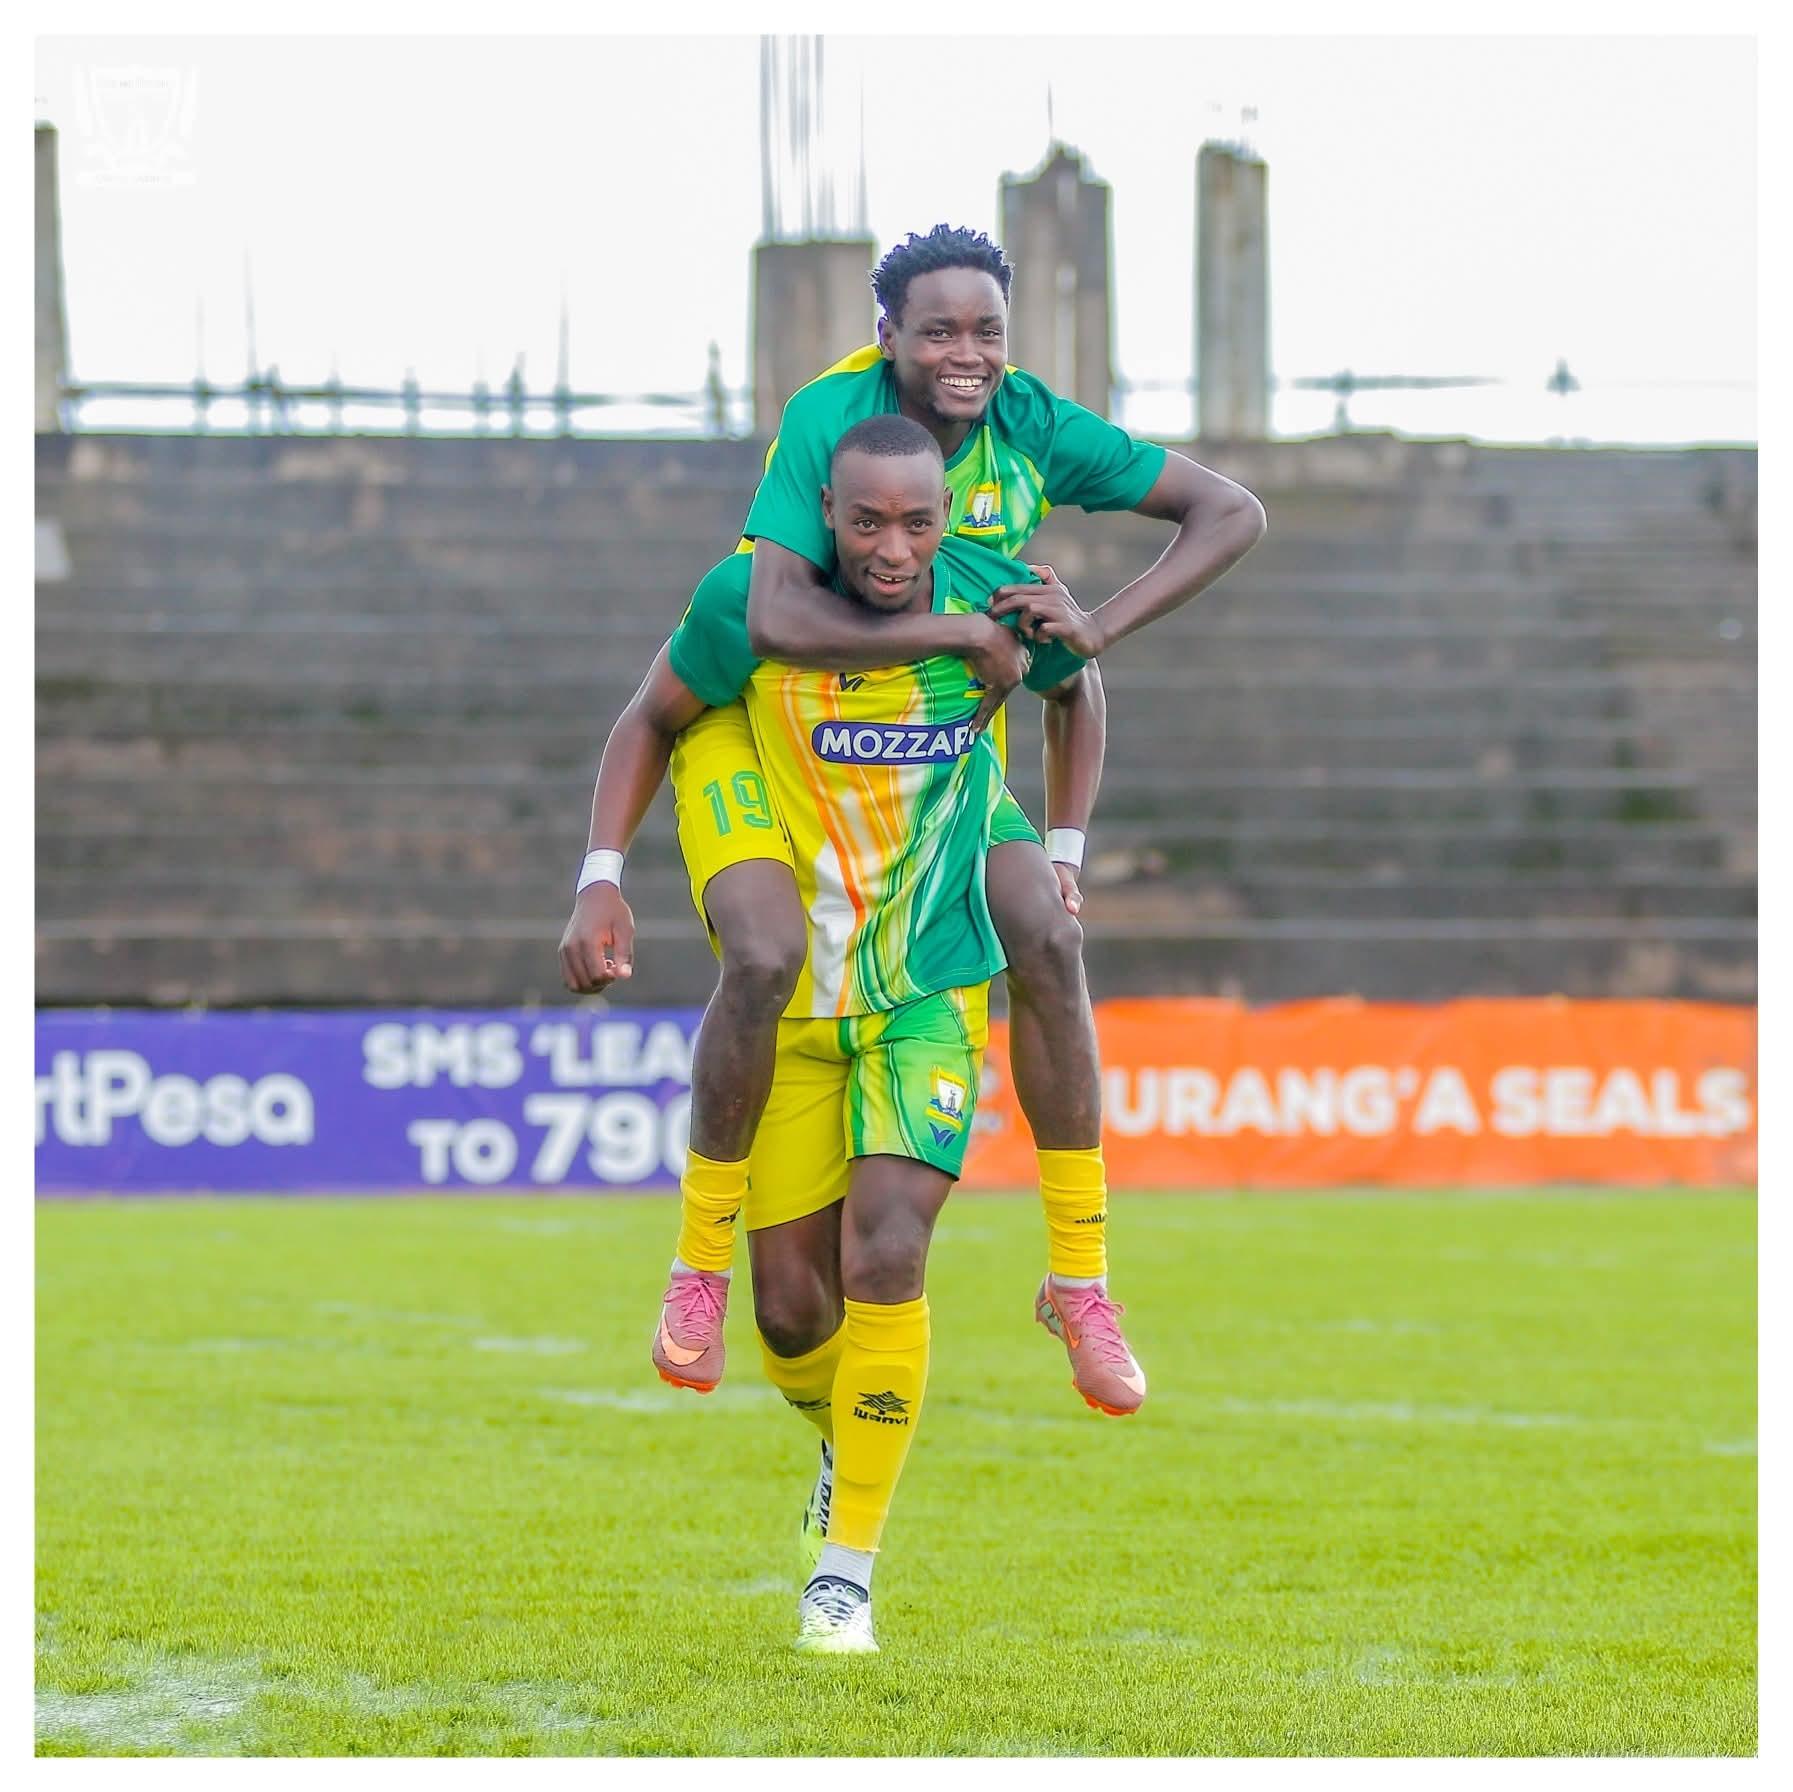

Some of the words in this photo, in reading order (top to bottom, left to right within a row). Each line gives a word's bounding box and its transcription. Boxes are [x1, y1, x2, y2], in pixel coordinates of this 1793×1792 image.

[703, 771, 772, 836] 19
[362, 1022, 524, 1088] SMS
[529, 1021, 698, 1087] 'LEA
[1099, 1066, 1479, 1135] URANG'A
[1489, 1065, 1748, 1136] SEALS
[406, 1118, 518, 1184] TO
